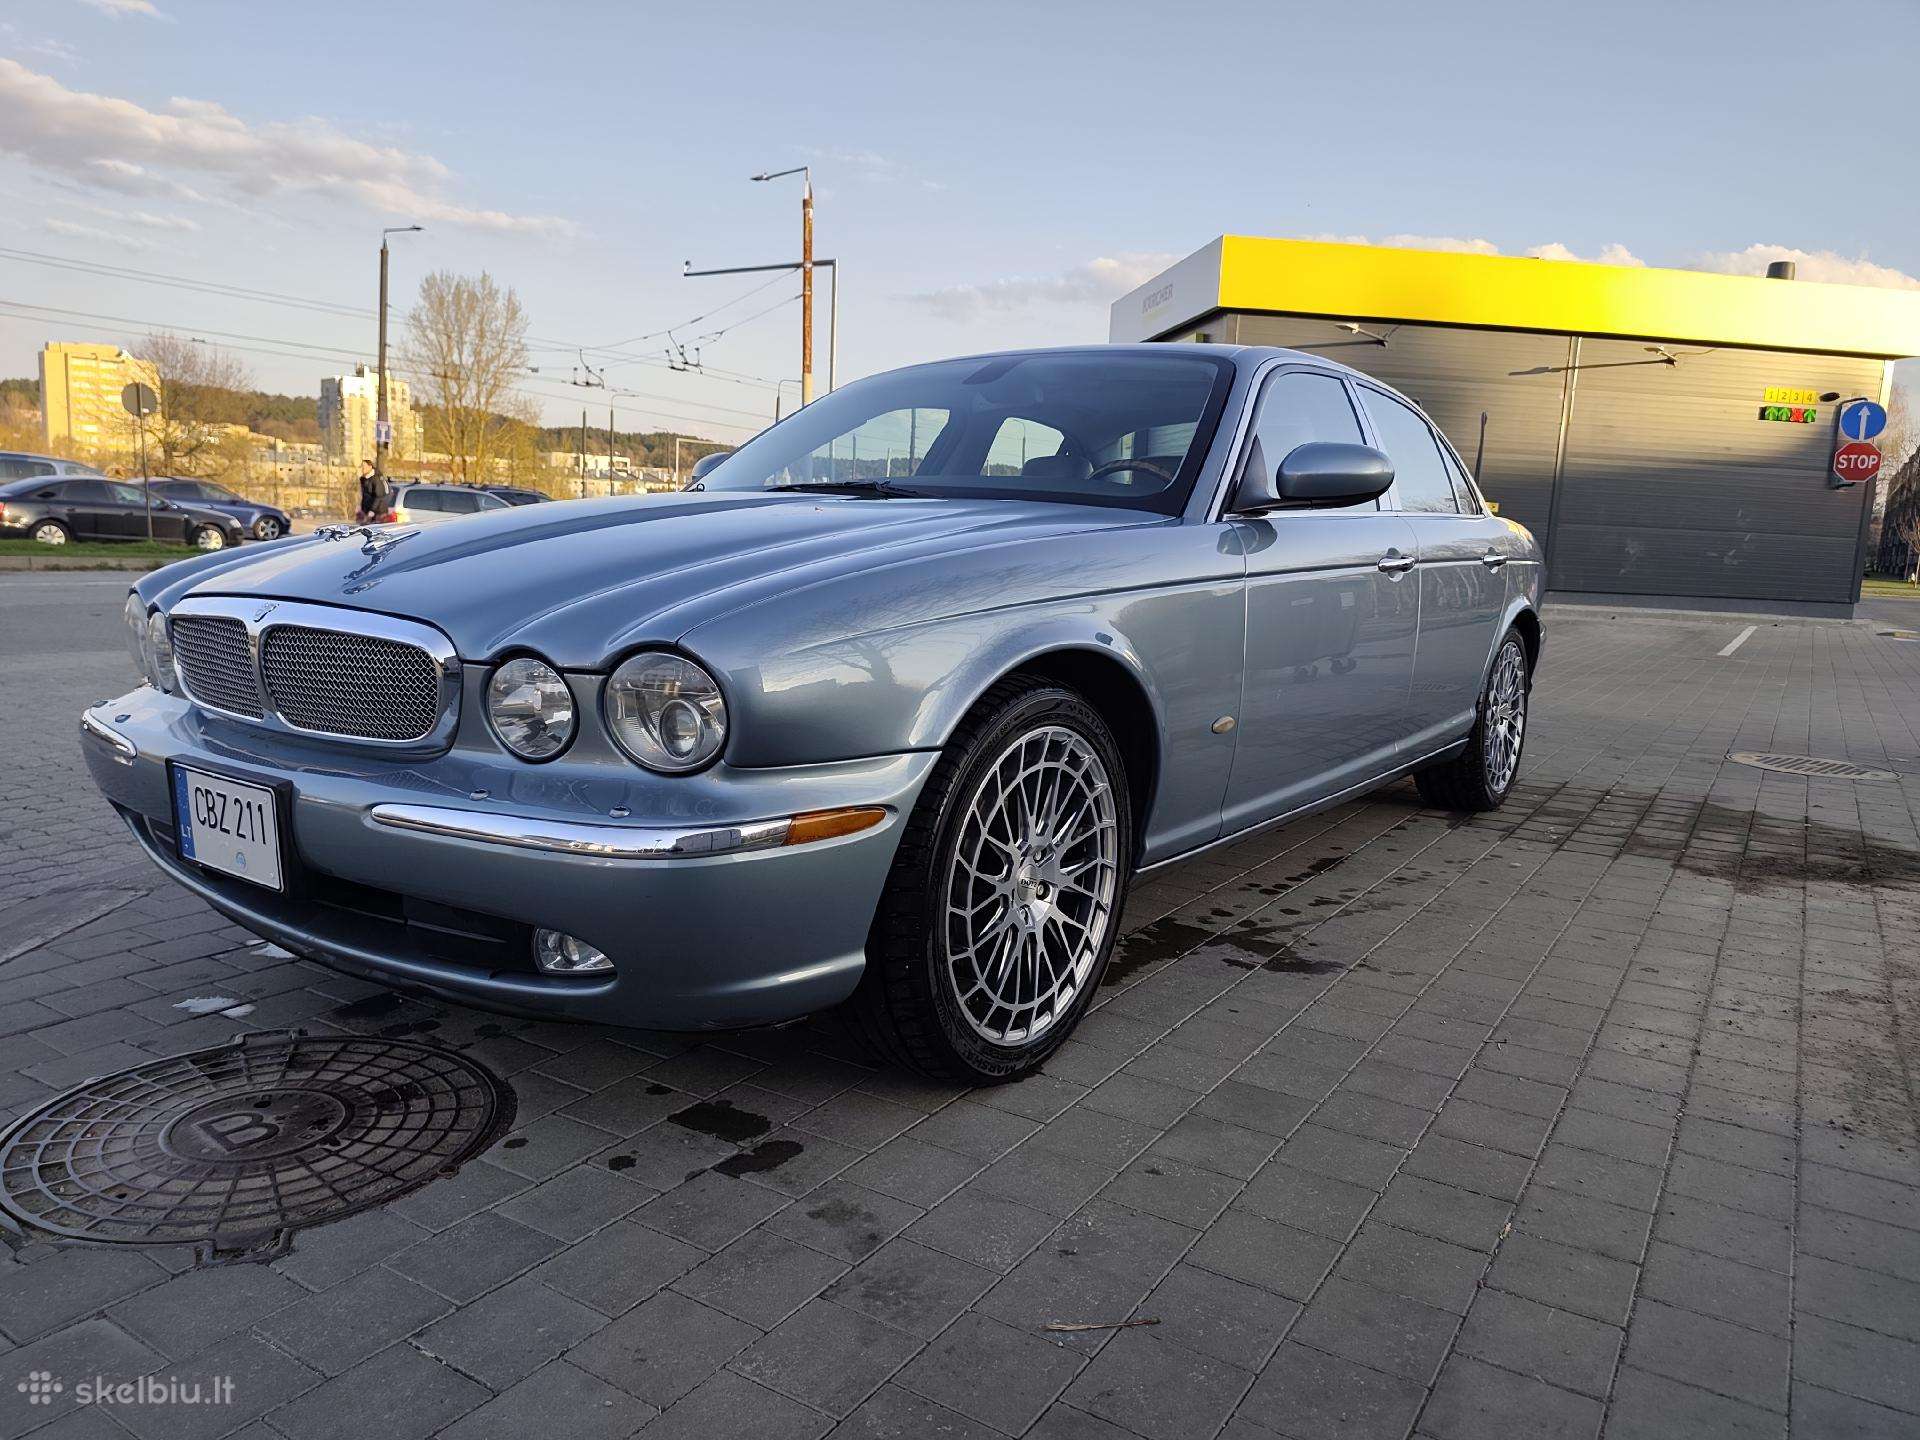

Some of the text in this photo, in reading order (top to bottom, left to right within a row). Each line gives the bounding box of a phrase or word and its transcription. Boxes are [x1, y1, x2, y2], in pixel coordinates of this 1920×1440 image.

[1768, 389, 1814, 402] 1 2 3 4
[1837, 454, 1879, 470] STOP
[194, 786, 267, 845] CBZ 211
